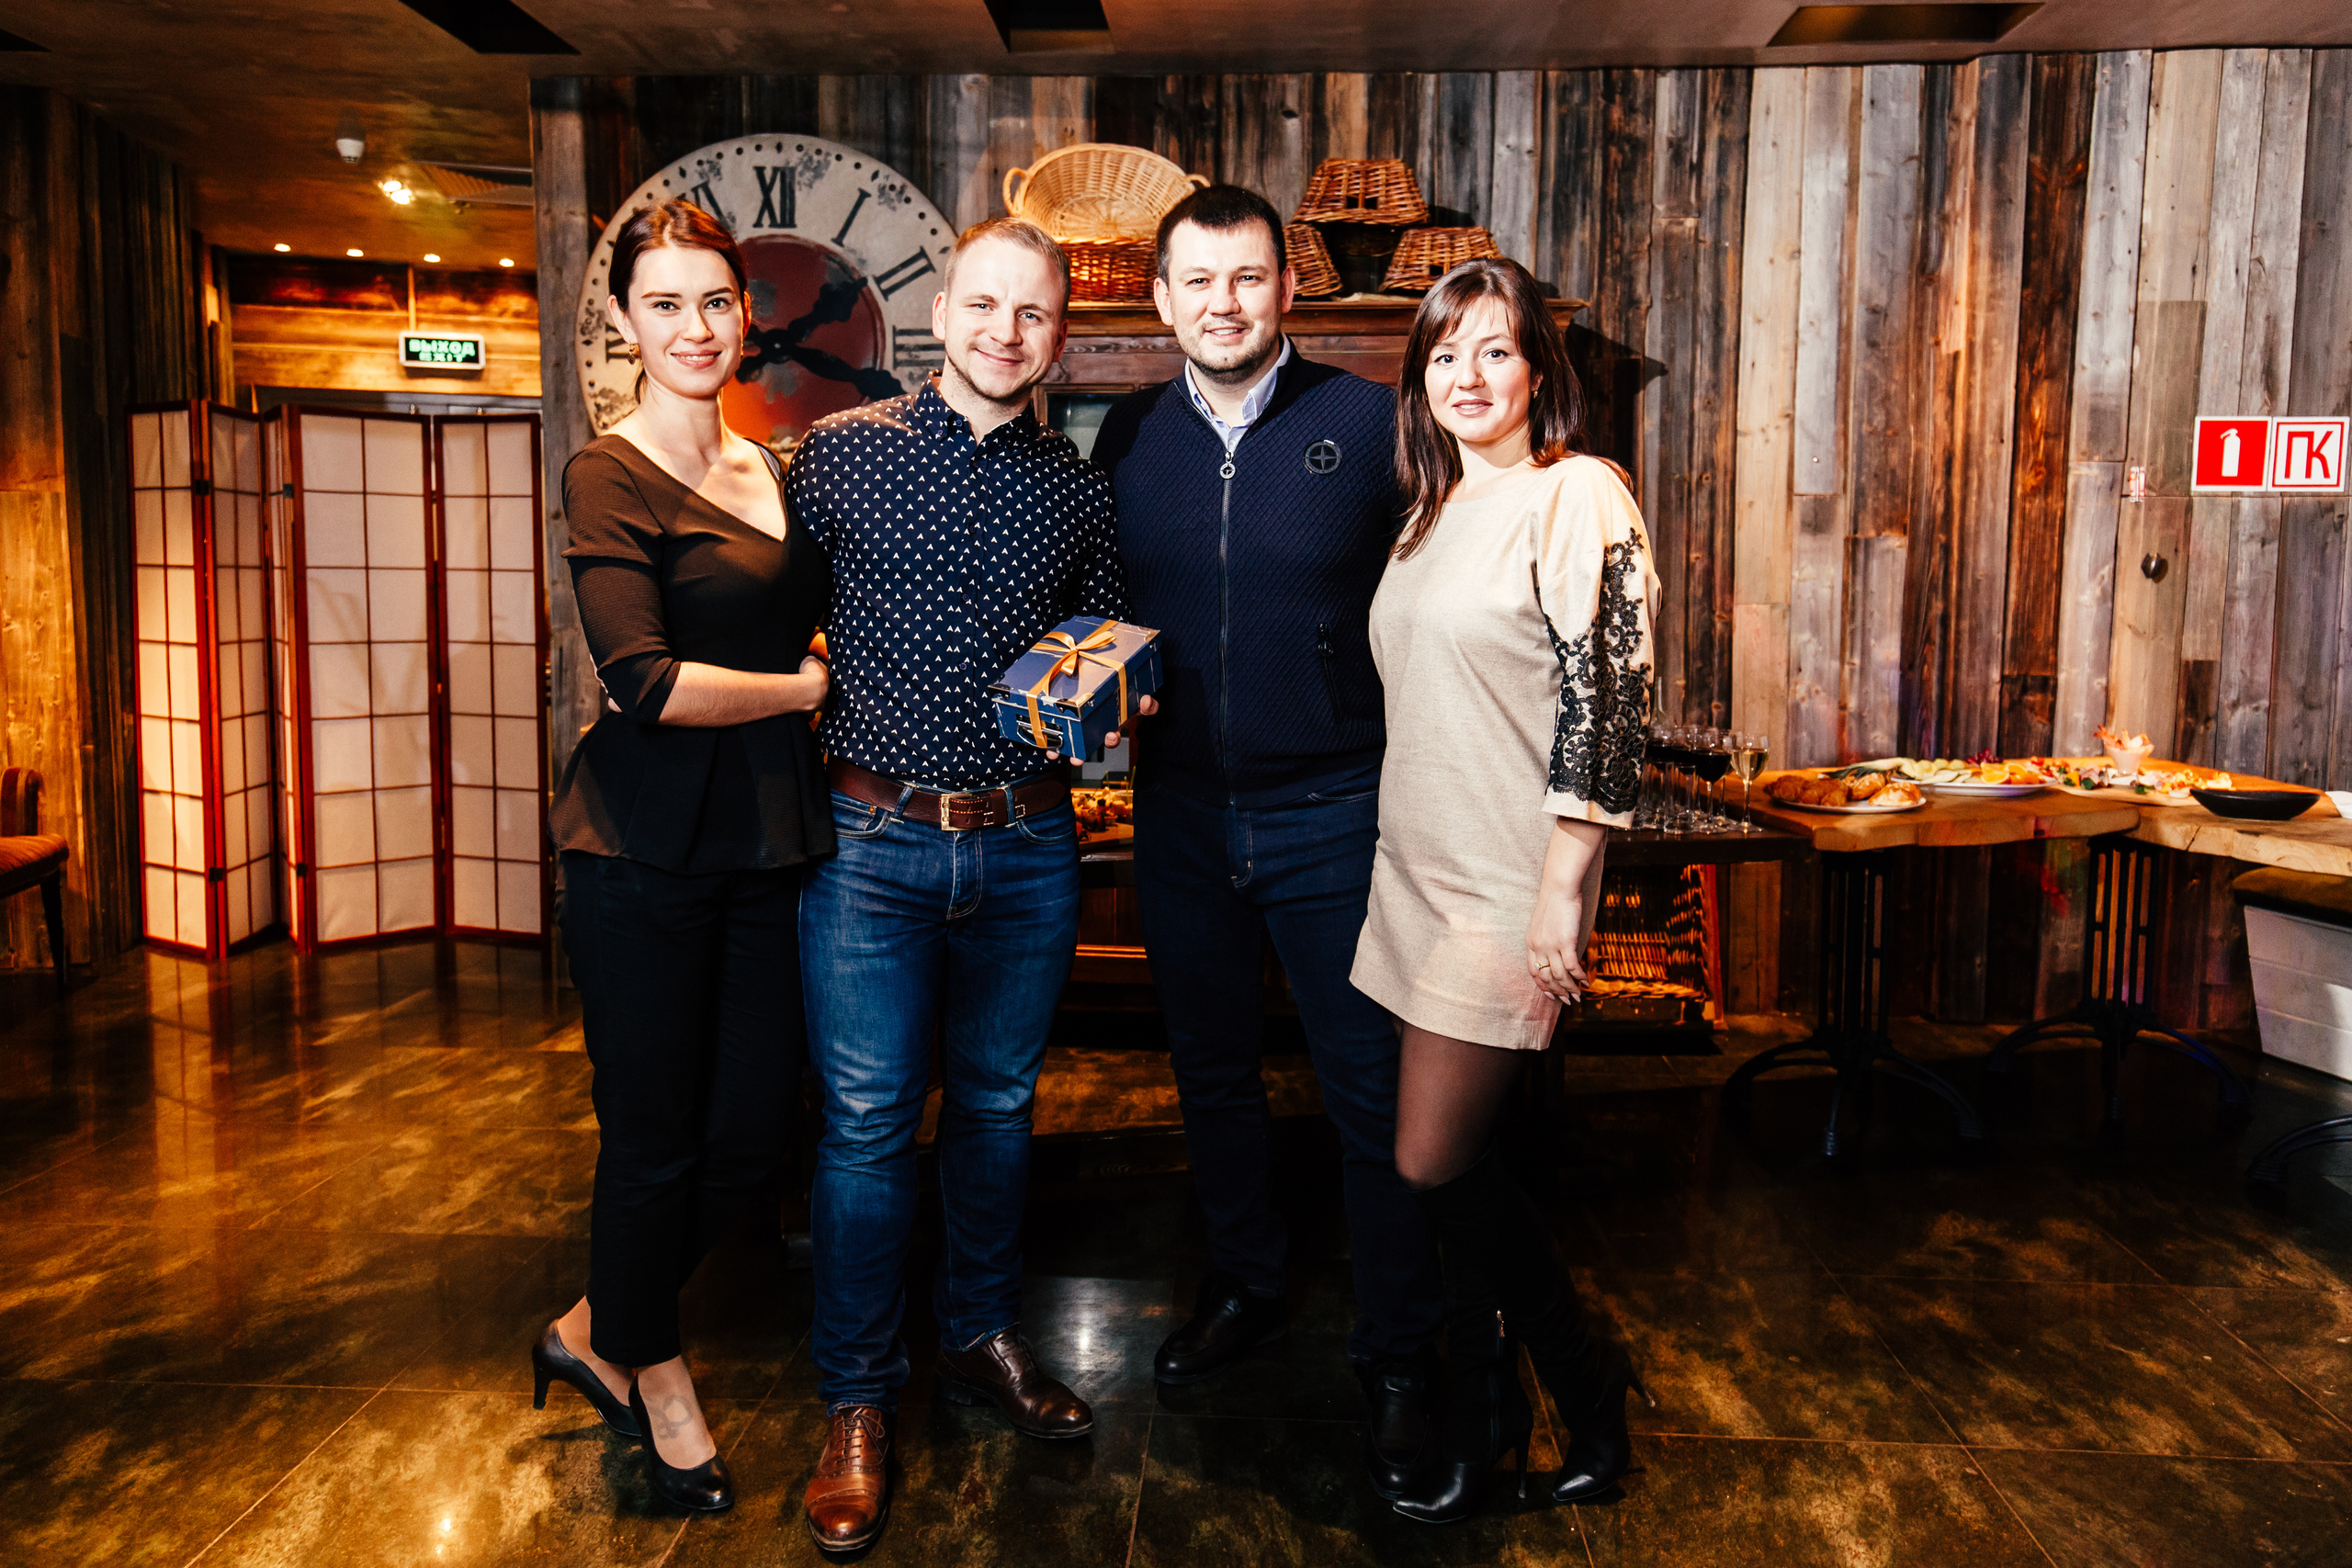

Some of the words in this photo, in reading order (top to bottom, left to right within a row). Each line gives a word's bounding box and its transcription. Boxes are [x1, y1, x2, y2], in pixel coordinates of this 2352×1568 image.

[752, 165, 797, 229] XII
[831, 187, 872, 247] I
[873, 245, 936, 301] II
[409, 338, 476, 357] ВЫХОД
[419, 351, 467, 363] EXIT
[2284, 430, 2334, 479] ПК
